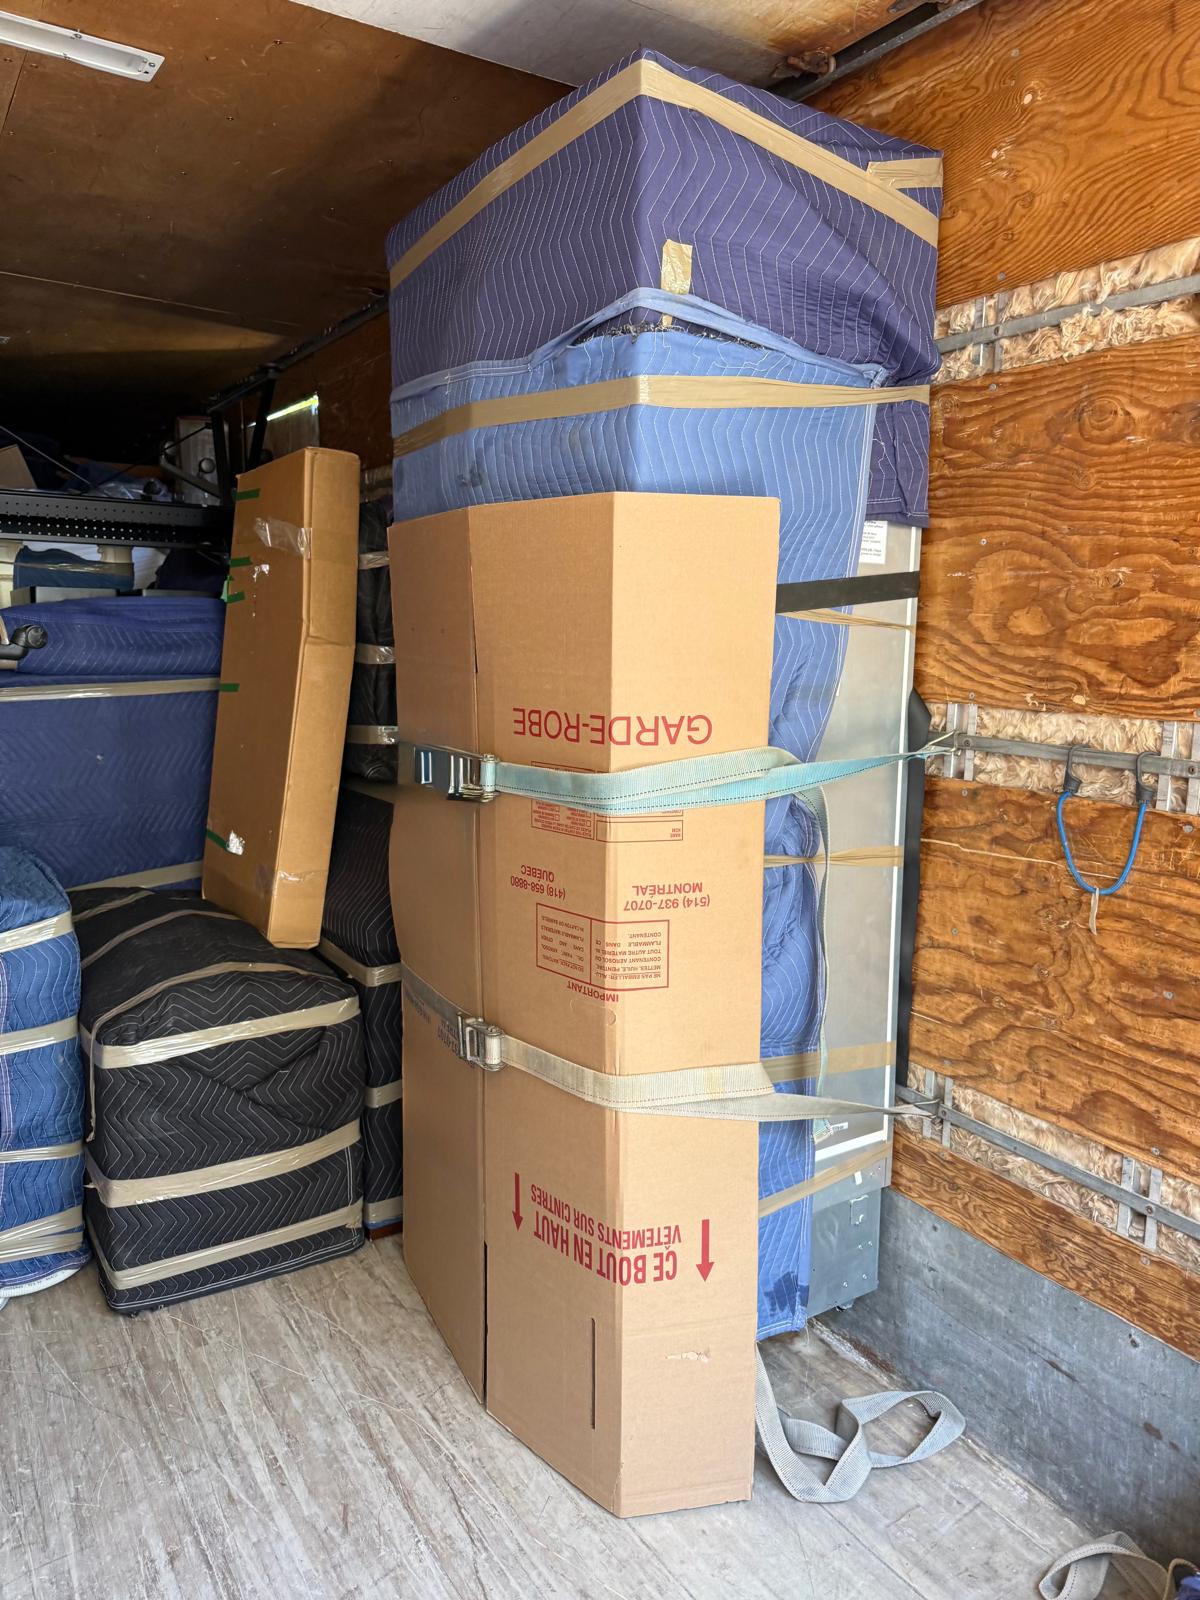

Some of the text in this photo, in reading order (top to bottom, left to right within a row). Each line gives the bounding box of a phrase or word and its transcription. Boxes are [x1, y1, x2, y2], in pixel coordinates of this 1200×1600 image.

[513, 708, 712, 746] GARDE-ROBE
[521, 865, 555, 883] QUÉBEC
[547, 884, 566, 900] (418)
[632, 882, 703, 898] MONTRÉAL
[624, 895, 710, 911] (514) 937-0707
[566, 980, 619, 1003] IMPORTANT
[531, 1184, 682, 1250] VÊTEMENTS SUR CINTRES
[534, 1211, 677, 1286] CE BOUT EN HAUT
